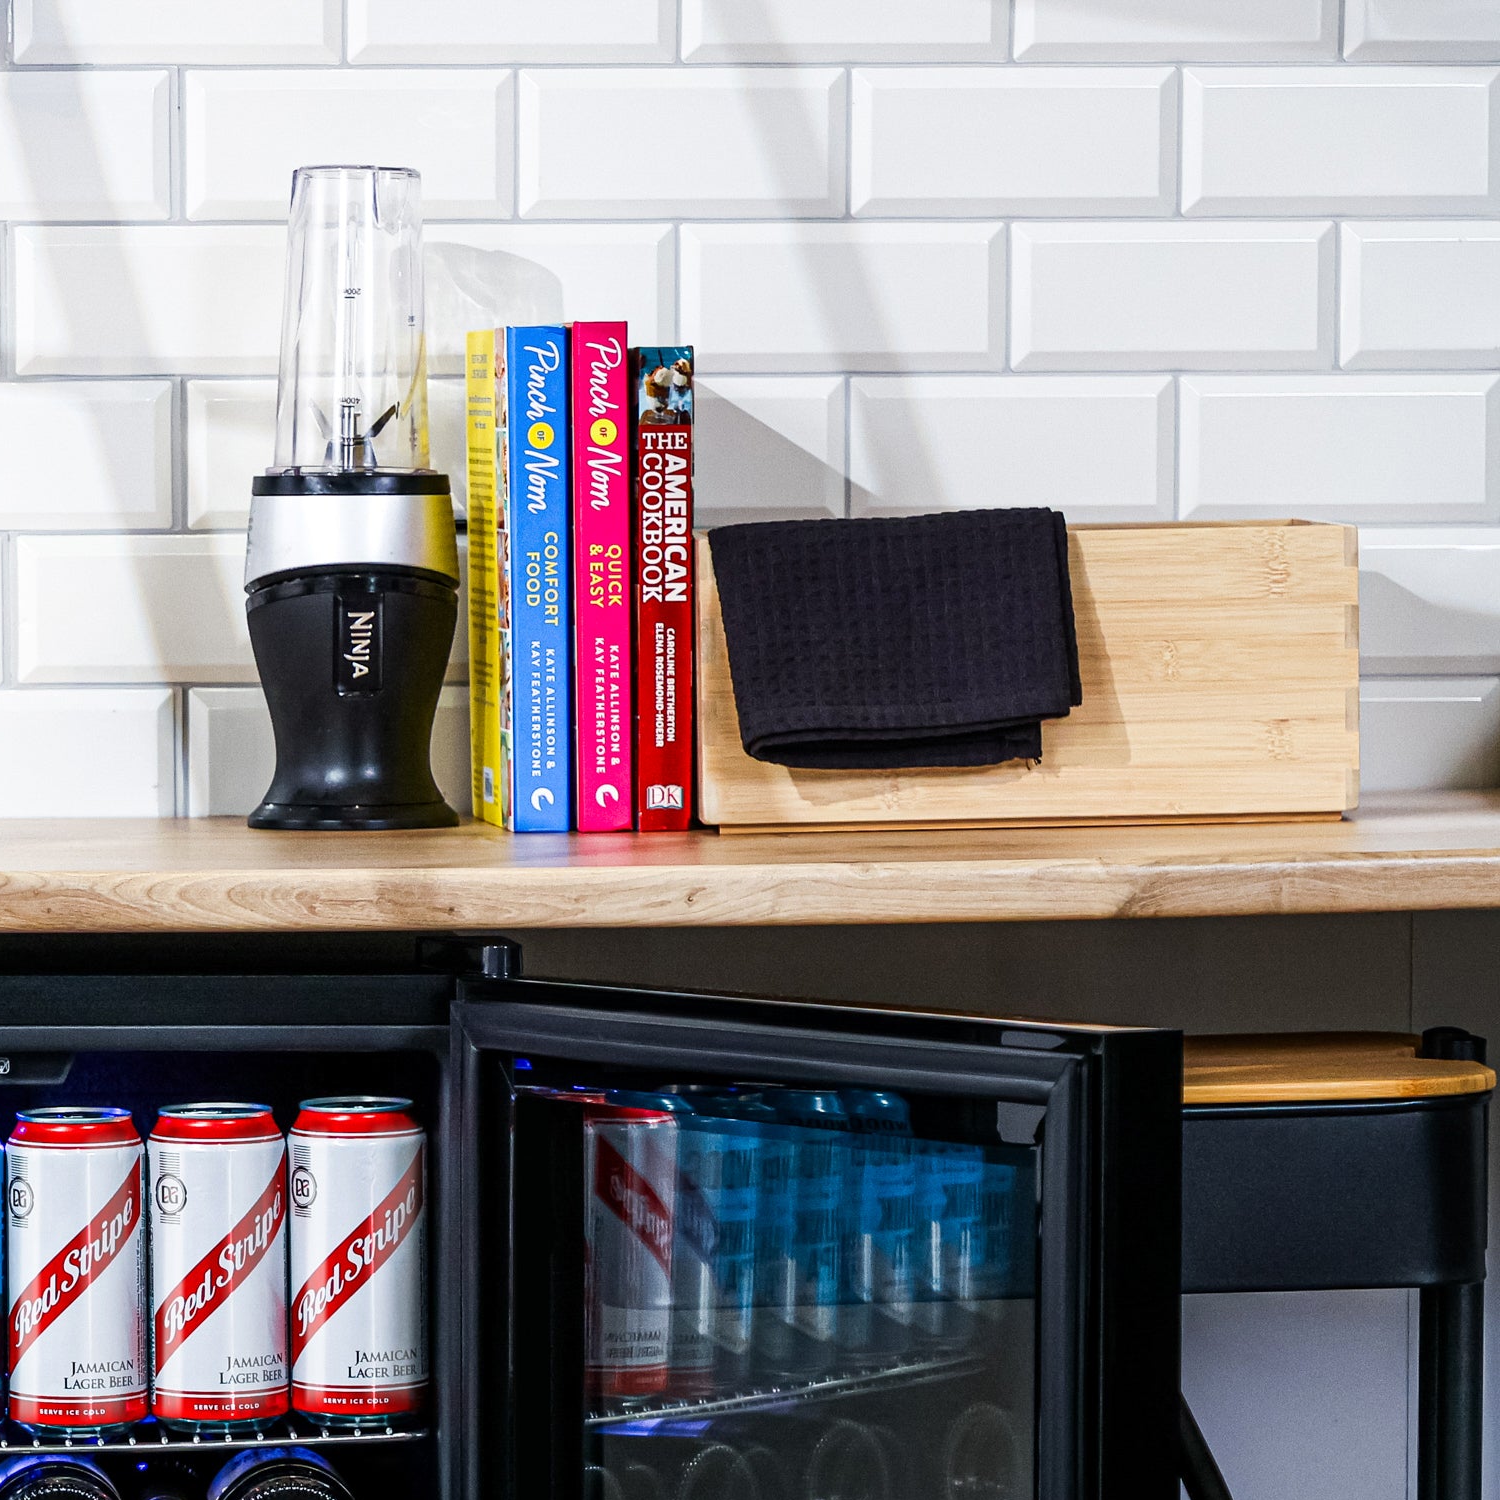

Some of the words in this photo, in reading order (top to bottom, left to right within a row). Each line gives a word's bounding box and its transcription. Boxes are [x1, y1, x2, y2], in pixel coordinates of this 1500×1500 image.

[524, 341, 560, 420] Pinch
[586, 337, 622, 418] Pinch
[536, 430, 545, 441] OF
[599, 427, 607, 438] OF
[642, 432, 688, 450] THE
[524, 450, 560, 515] Nom
[586, 447, 622, 511] Nom
[590, 544, 604, 556] &
[642, 453, 663, 604] COOKBOOK
[665, 453, 688, 603] AMERICAN
[526, 552, 541, 607] FOOD
[543, 532, 559, 627] COMFORT
[590, 562, 604, 608] EASY
[604, 545, 622, 607] QUICK
[344, 611, 375, 678] NINJA
[531, 641, 541, 669] KAY
[595, 638, 605, 664] KAY
[655, 623, 664, 655] ELENA
[666, 628, 675, 673] CAROLINE
[546, 649, 555, 682] KATE
[610, 645, 619, 679] KATE
[546, 688, 556, 756] ALLINSON
[595, 669, 605, 774] FEATHERSTONE
[610, 685, 620, 753] ALLINSON
[655, 656, 664, 747] ROSEMOND-HOERR
[666, 675, 675, 742] BRETHERTON
[531, 673, 541, 777] FEATHERSTONE
[546, 760, 556, 769] &
[611, 757, 620, 766] &
[651, 788, 680, 805] DK
[15, 1275, 61, 1348] Red
[61, 1197, 134, 1293] Stripe
[164, 1270, 216, 1345] Red
[215, 1190, 281, 1288] Stripe
[298, 1263, 345, 1337] Red
[344, 1185, 416, 1282] Stripe
[71, 1359, 134, 1377] JAMAICAN
[219, 1372, 259, 1385] LAGER
[262, 1370, 283, 1383] BEER
[226, 1354, 283, 1372] JAMAICAN
[348, 1366, 390, 1379] LAGER
[393, 1364, 417, 1376] BEER
[355, 1349, 417, 1367] JAMAICAN
[64, 1377, 106, 1390] LAGER
[109, 1376, 134, 1387] BEER
[323, 1397, 348, 1405] SERVE
[39, 1408, 64, 1416] SERVE
[82, 1408, 106, 1416] COLD
